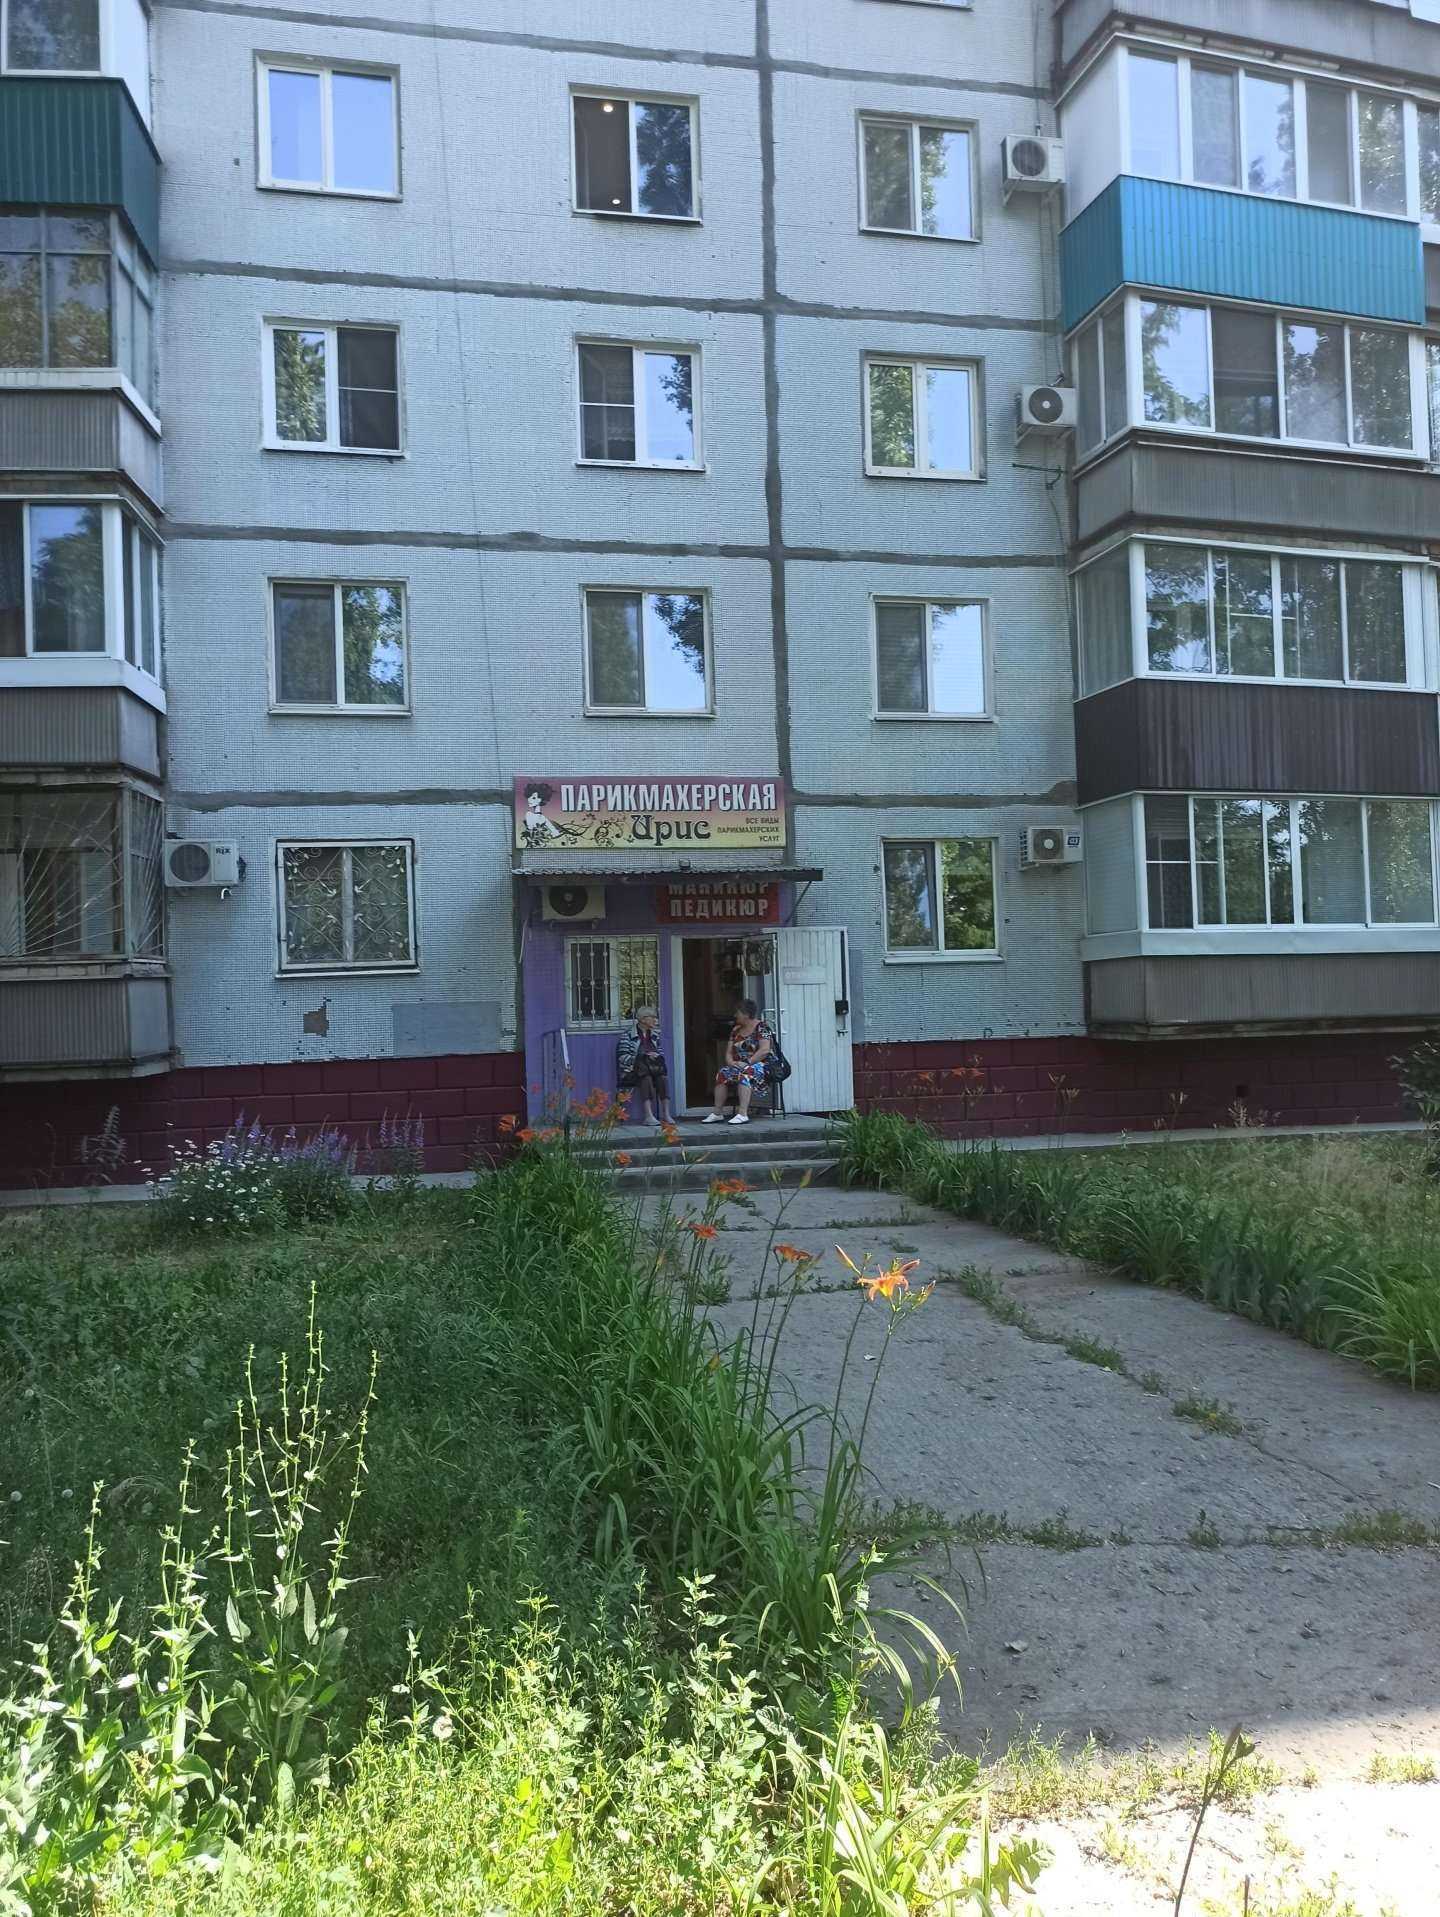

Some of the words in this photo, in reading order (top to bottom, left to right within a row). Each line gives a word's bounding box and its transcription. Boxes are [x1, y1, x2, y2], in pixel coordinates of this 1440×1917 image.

[560, 783, 777, 812] ПАРИКМАХЕРСКАЯ
[630, 814, 711, 846] Ирис
[670, 898, 769, 919] ПЕДИКЮР
